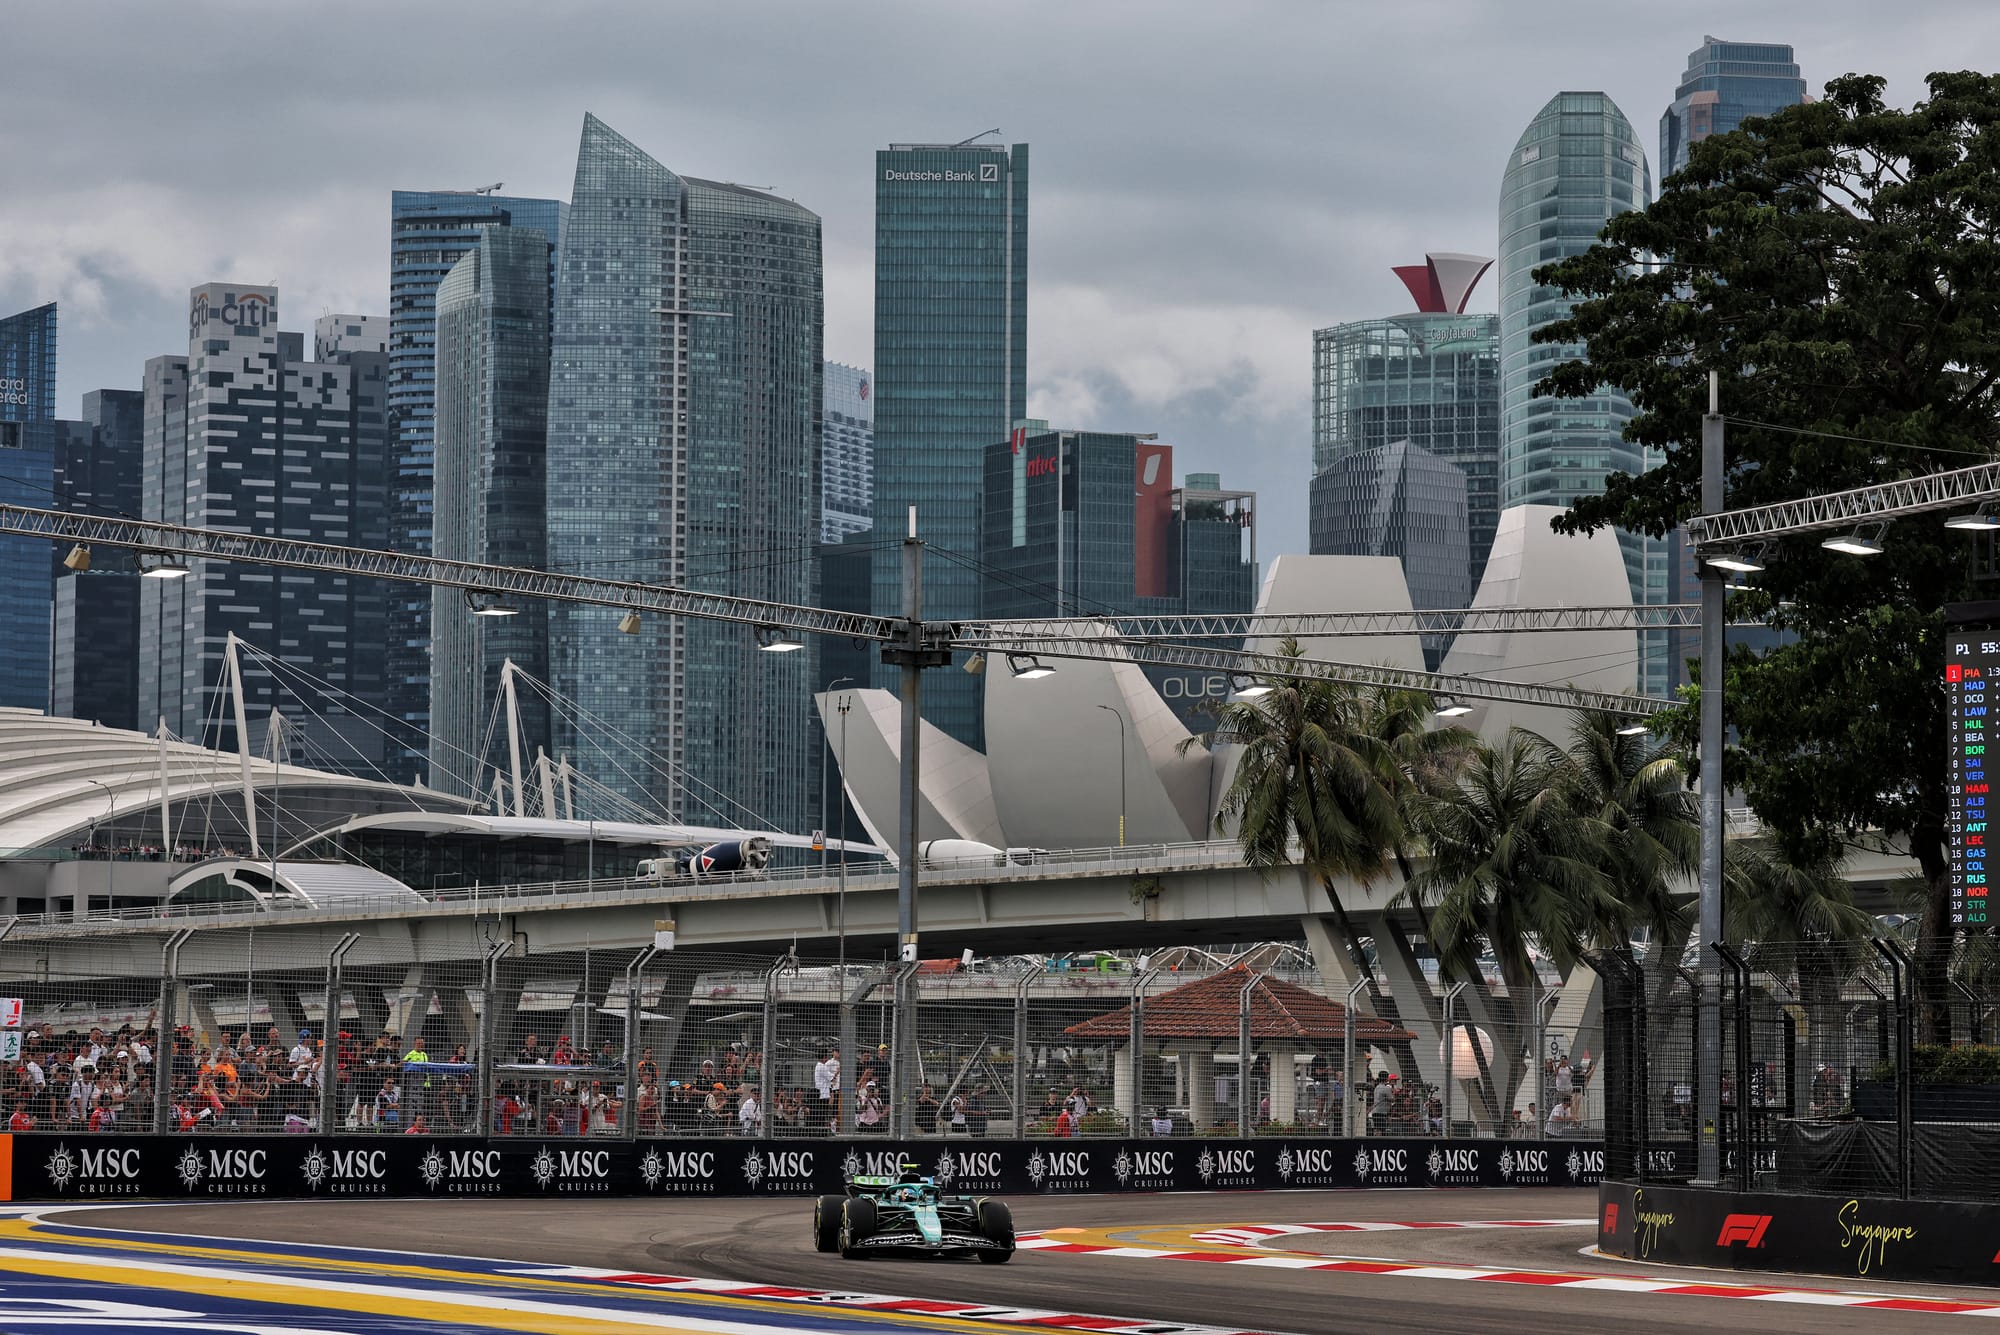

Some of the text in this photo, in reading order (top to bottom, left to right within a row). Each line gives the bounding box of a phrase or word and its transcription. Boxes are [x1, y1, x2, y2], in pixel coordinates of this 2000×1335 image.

[885, 169, 976, 181] Deutsche Bank
[192, 299, 209, 328] citi
[221, 299, 268, 328] citi
[1026, 455, 1057, 478] ntuc
[1955, 643, 1970, 655] P1
[1951, 670, 1957, 679] 1
[1964, 668, 1981, 678] PIA
[1163, 675, 1227, 698] OUE
[1951, 681, 1986, 692] 2 HAD
[1951, 694, 1984, 705] 3 OCO
[1951, 706, 1987, 717] 4 LAW
[1952, 719, 1985, 730] 5 HUL
[1952, 732, 1985, 743] 6 BEA
[1952, 745, 1985, 756] 7 BOR
[1952, 758, 1982, 769] 8 SAI
[1952, 771, 1985, 781] 9 VER
[1951, 783, 1989, 794] 10 HAM
[1951, 797, 1985, 807] 11 ALB
[1951, 810, 1985, 820] 12 TSU
[1951, 822, 1988, 833] 13 ANT
[1951, 835, 1985, 846] 14 LEC
[1951, 848, 1986, 859] 15 GAS
[1952, 861, 1985, 871] 16 COL
[1952, 874, 1986, 885] 17 RUS
[1952, 887, 1989, 897] 18 NOR
[1952, 900, 1987, 910] 19 STR
[1952, 912, 1987, 923] 20 ALO
[80, 1149, 140, 1178] MSC
[209, 1150, 266, 1178] MSC
[332, 1151, 386, 1178] MSC
[449, 1151, 501, 1178] MSC
[559, 1151, 609, 1177] MSC
[666, 1152, 714, 1178] MSC
[768, 1152, 814, 1177] MSC
[866, 1152, 910, 1176] MSC
[958, 1152, 1001, 1177] MSC
[1048, 1152, 1090, 1176] MSC
[1135, 1152, 1174, 1175] MSC
[1218, 1150, 1255, 1173] MSC
[1296, 1150, 1332, 1172] MSC
[1373, 1150, 1408, 1172] MSC
[1445, 1150, 1479, 1172] MSC
[1516, 1151, 1548, 1172] MSC
[1583, 1151, 1604, 1172] MS
[1049, 1180, 1090, 1189] CRUISES
[1135, 1179, 1174, 1188] CRUISES
[1218, 1177, 1255, 1186] CRUISES
[1296, 1176, 1332, 1184] CRUISES
[79, 1184, 140, 1193] CRUISES
[208, 1184, 266, 1193] CRUISES
[331, 1183, 386, 1193] CRUISES
[448, 1183, 501, 1192] CRUISES
[559, 1182, 609, 1191] CRUISES
[666, 1183, 714, 1192] CRUISES
[768, 1182, 814, 1191] CRUISES
[959, 1182, 1001, 1190] CRUISES
[1632, 1189, 1676, 1258] Singapore
[1716, 1213, 1774, 1248] F1
[1838, 1200, 1918, 1274] Singapore
